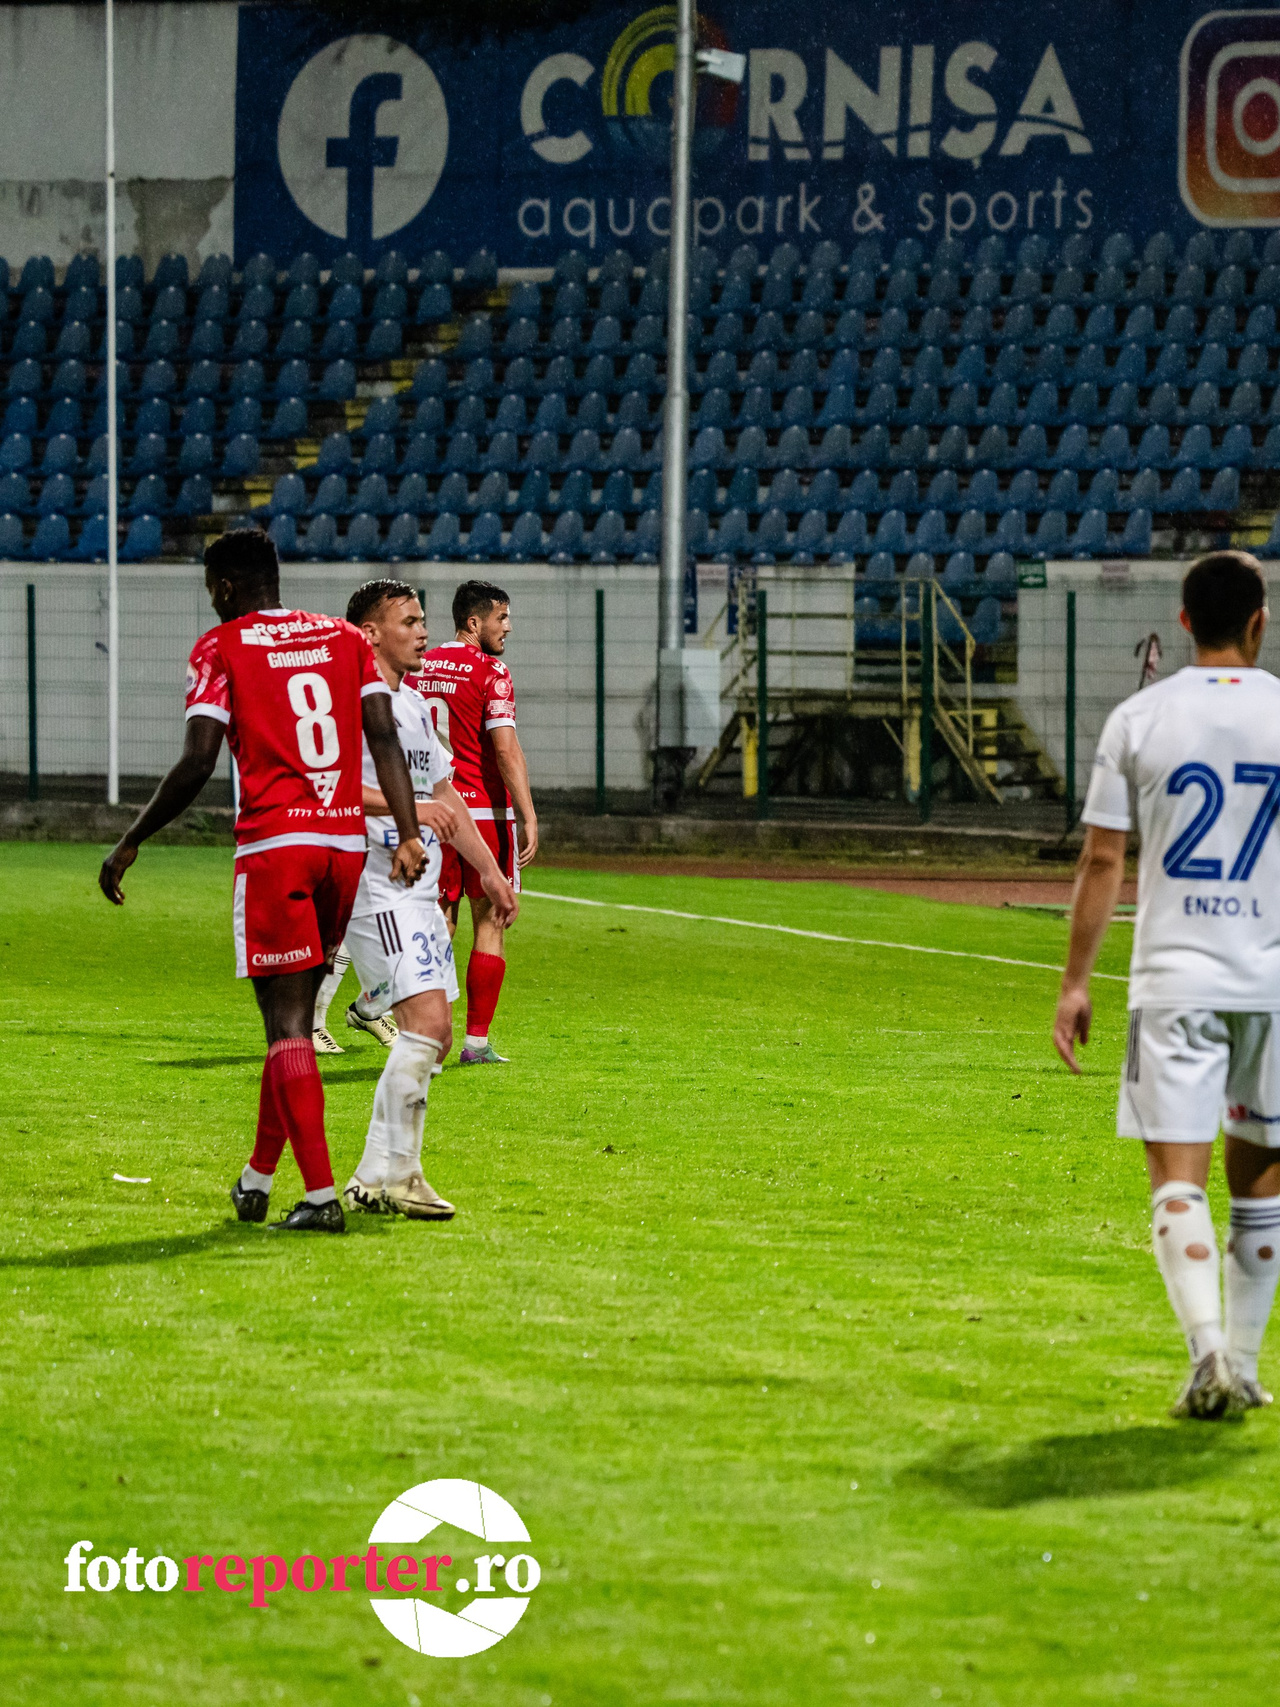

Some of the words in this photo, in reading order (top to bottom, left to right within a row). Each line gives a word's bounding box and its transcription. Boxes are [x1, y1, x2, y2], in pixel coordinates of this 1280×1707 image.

[518, 182, 821, 249] aquapark
[852, 182, 885, 233] &
[917, 176, 1093, 239] sports
[253, 619, 335, 639] Regata.ro
[417, 680, 457, 694] SELMANI
[287, 672, 340, 769] 8
[287, 808, 312, 818] 7777
[252, 945, 312, 966] CARPATINA
